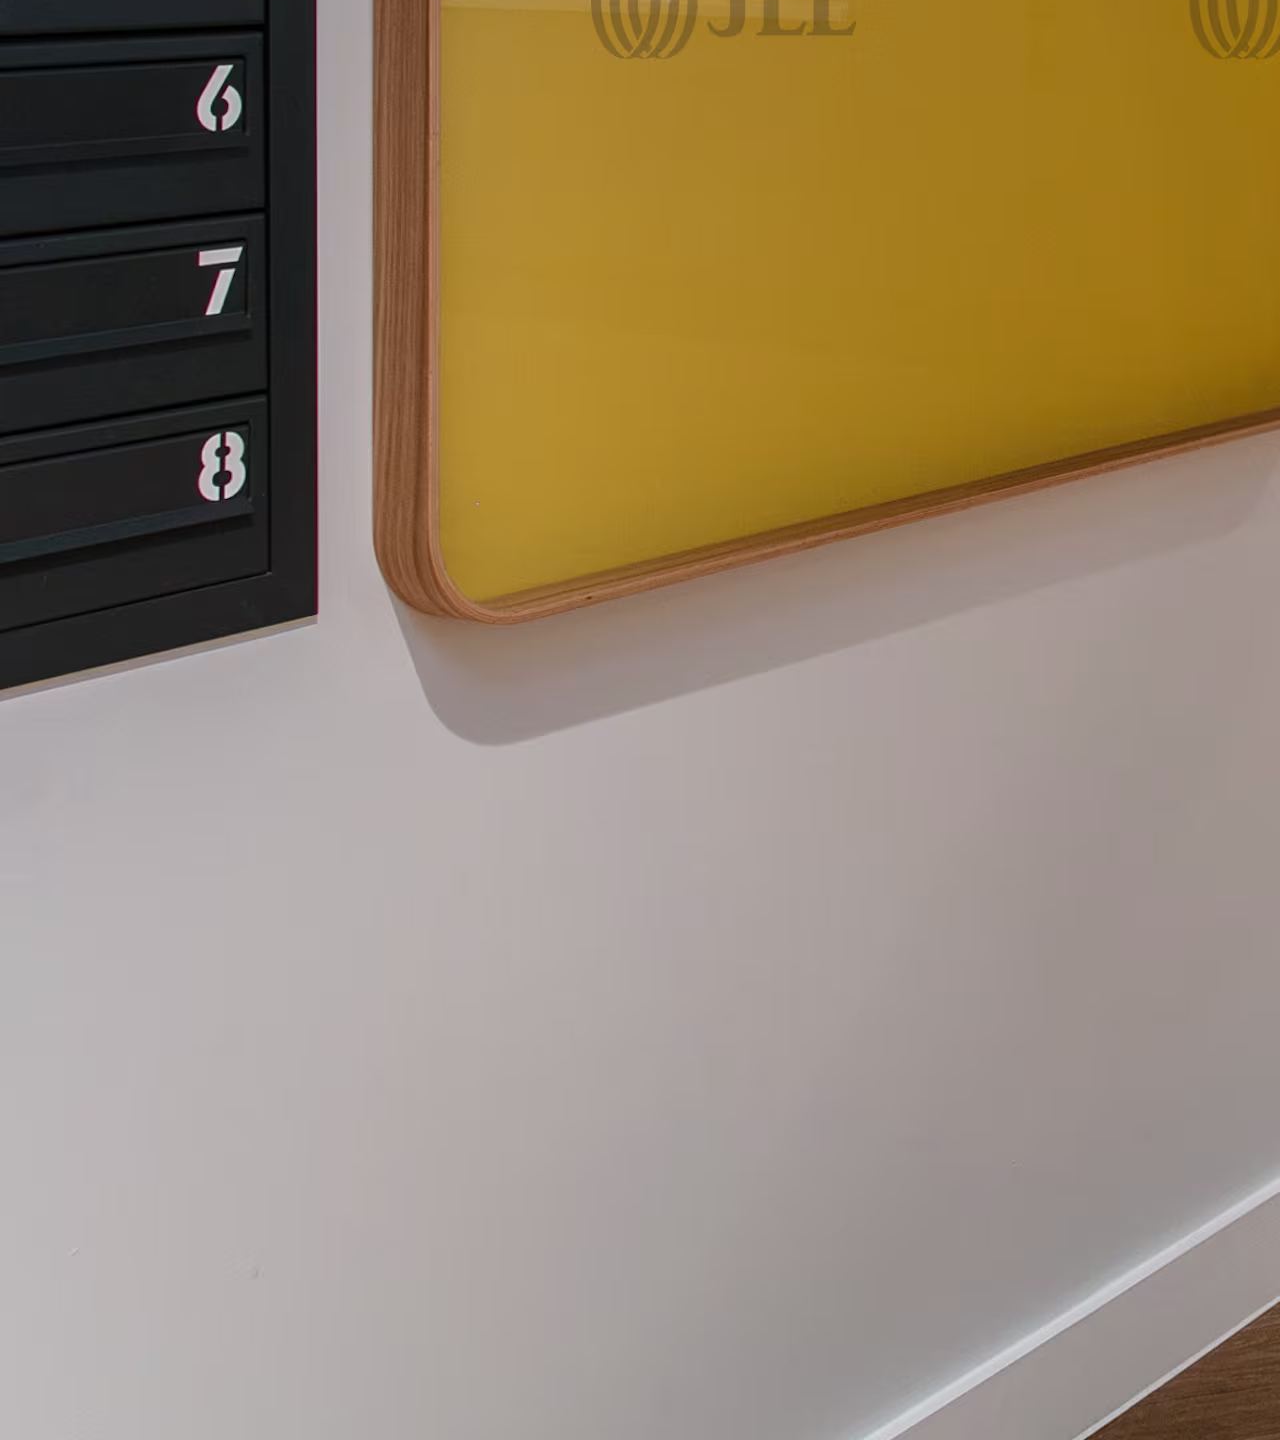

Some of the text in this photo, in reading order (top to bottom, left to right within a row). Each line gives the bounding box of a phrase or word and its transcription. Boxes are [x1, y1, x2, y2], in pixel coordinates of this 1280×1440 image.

[196, 64, 243, 132] 6
[198, 246, 244, 316] 7
[198, 431, 246, 502] 8
